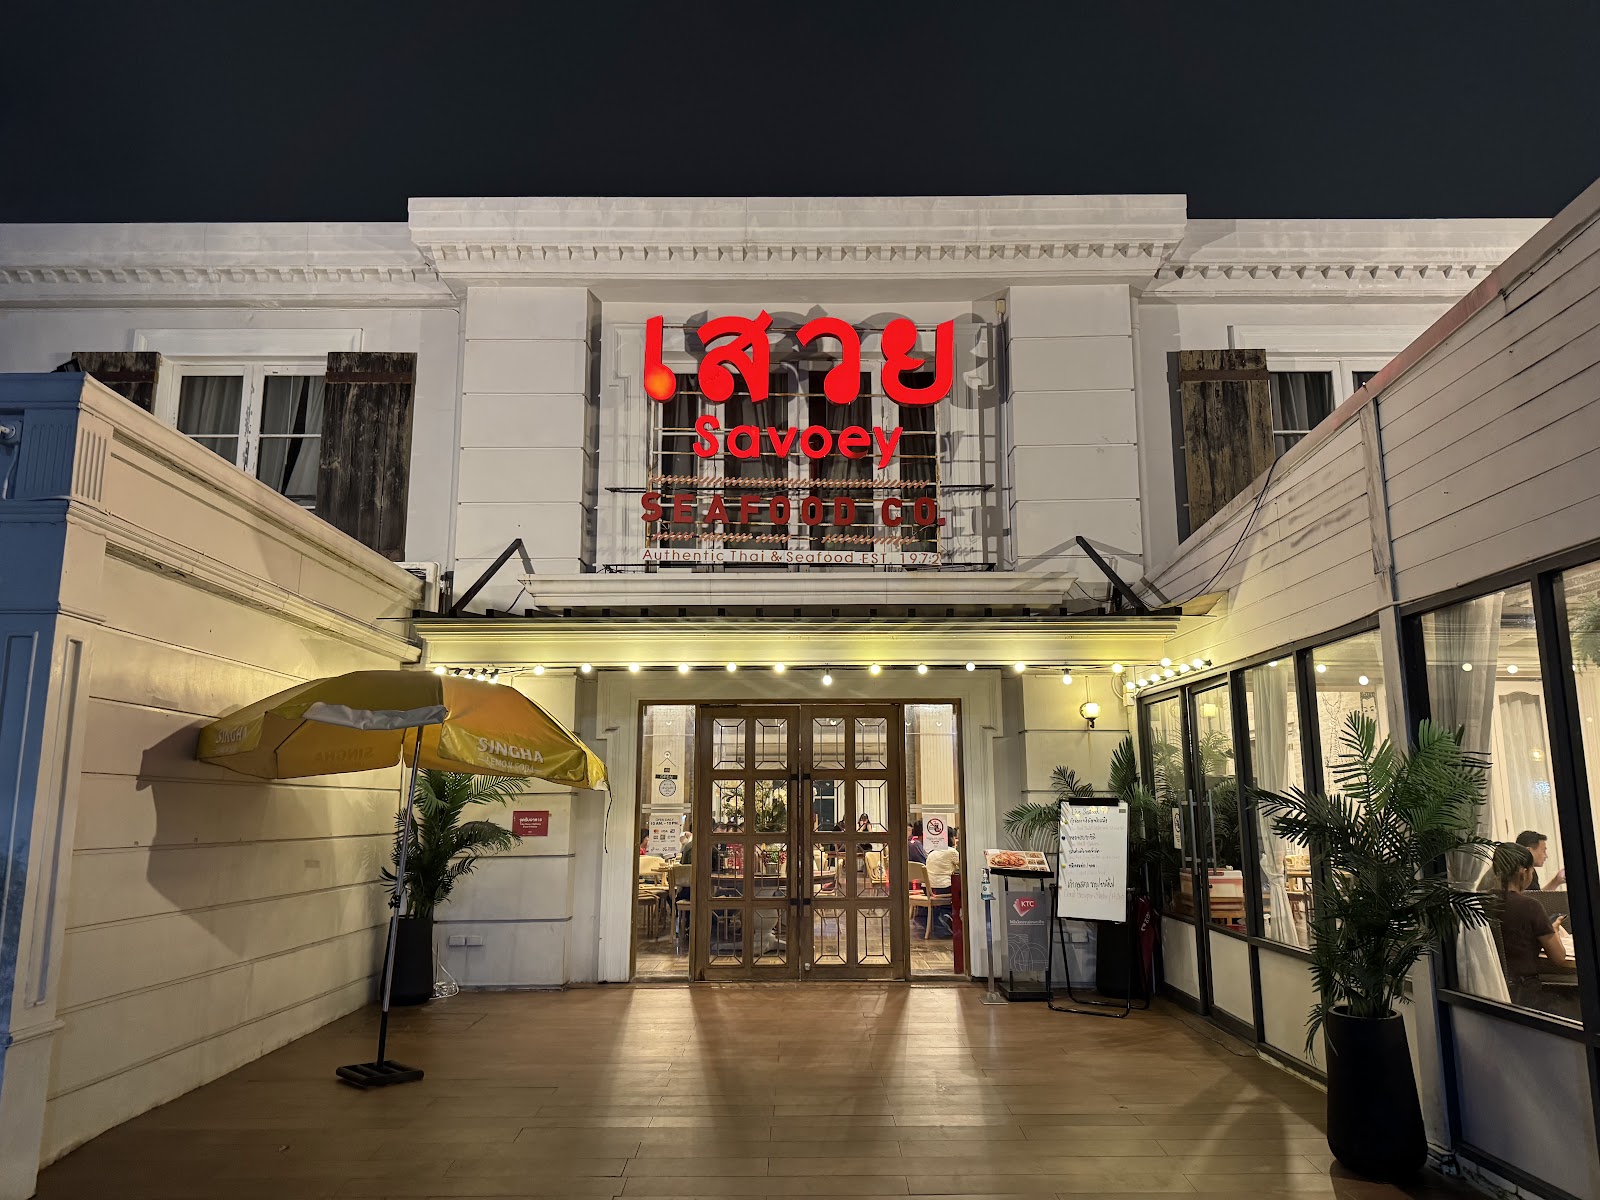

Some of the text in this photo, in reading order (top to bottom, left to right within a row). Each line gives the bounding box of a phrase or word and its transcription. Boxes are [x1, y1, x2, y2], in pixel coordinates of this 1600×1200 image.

[643, 309, 954, 405] เสวย
[692, 414, 903, 470] Savoey
[640, 491, 946, 528] SEAFOOD CO.
[642, 548, 725, 562] Authentic
[730, 550, 765, 562] Thai
[770, 550, 780, 562] &
[786, 550, 855, 563] Seafood
[899, 552, 941, 566] 1972
[215, 726, 248, 744] SINGHA
[478, 737, 544, 764] SINGHA
[486, 756, 535, 774] LEMON SODA
